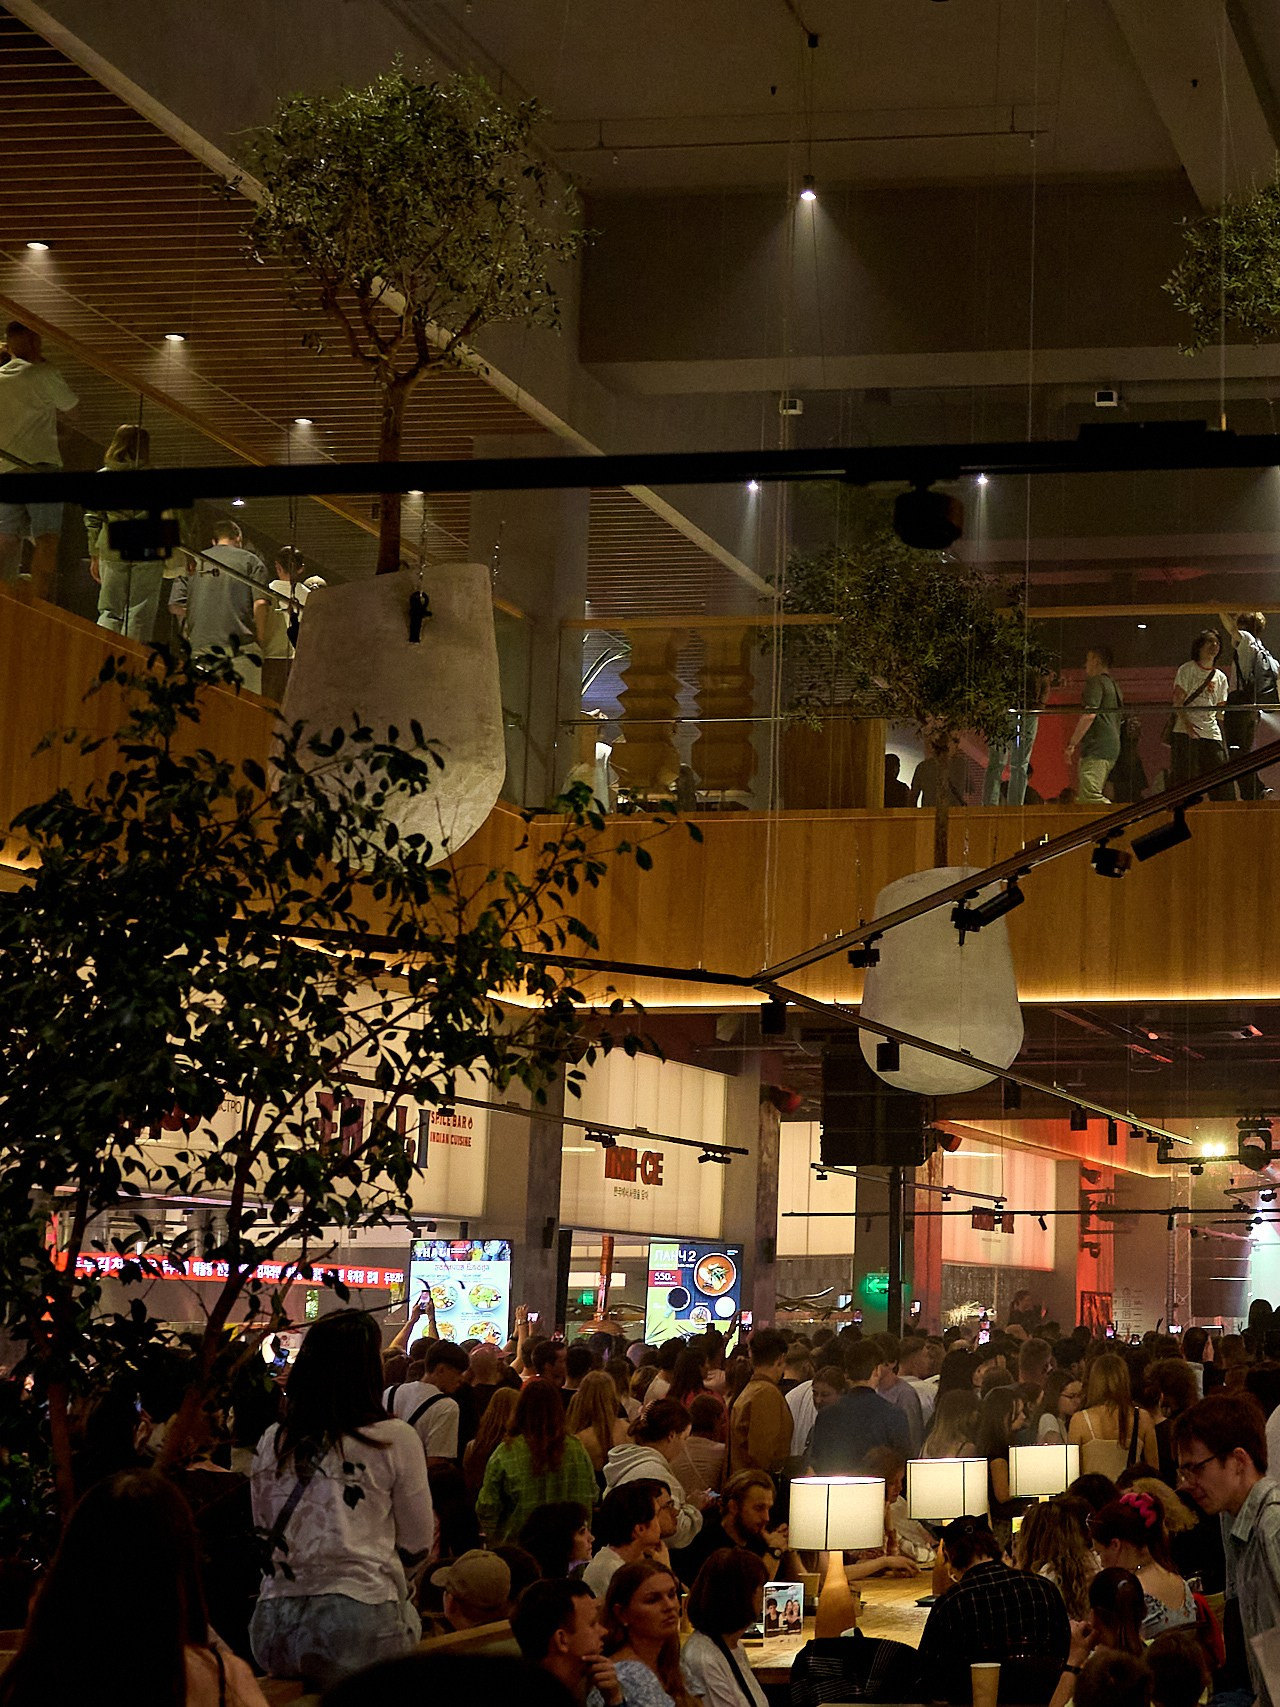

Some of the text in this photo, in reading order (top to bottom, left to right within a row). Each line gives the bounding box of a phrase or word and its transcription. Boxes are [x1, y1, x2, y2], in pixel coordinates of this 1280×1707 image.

[452, 1114, 467, 1129] BAR
[430, 1131, 472, 1147] INDIAN CUISINE
[655, 1250, 697, 1262] ЛАНЧ 2
